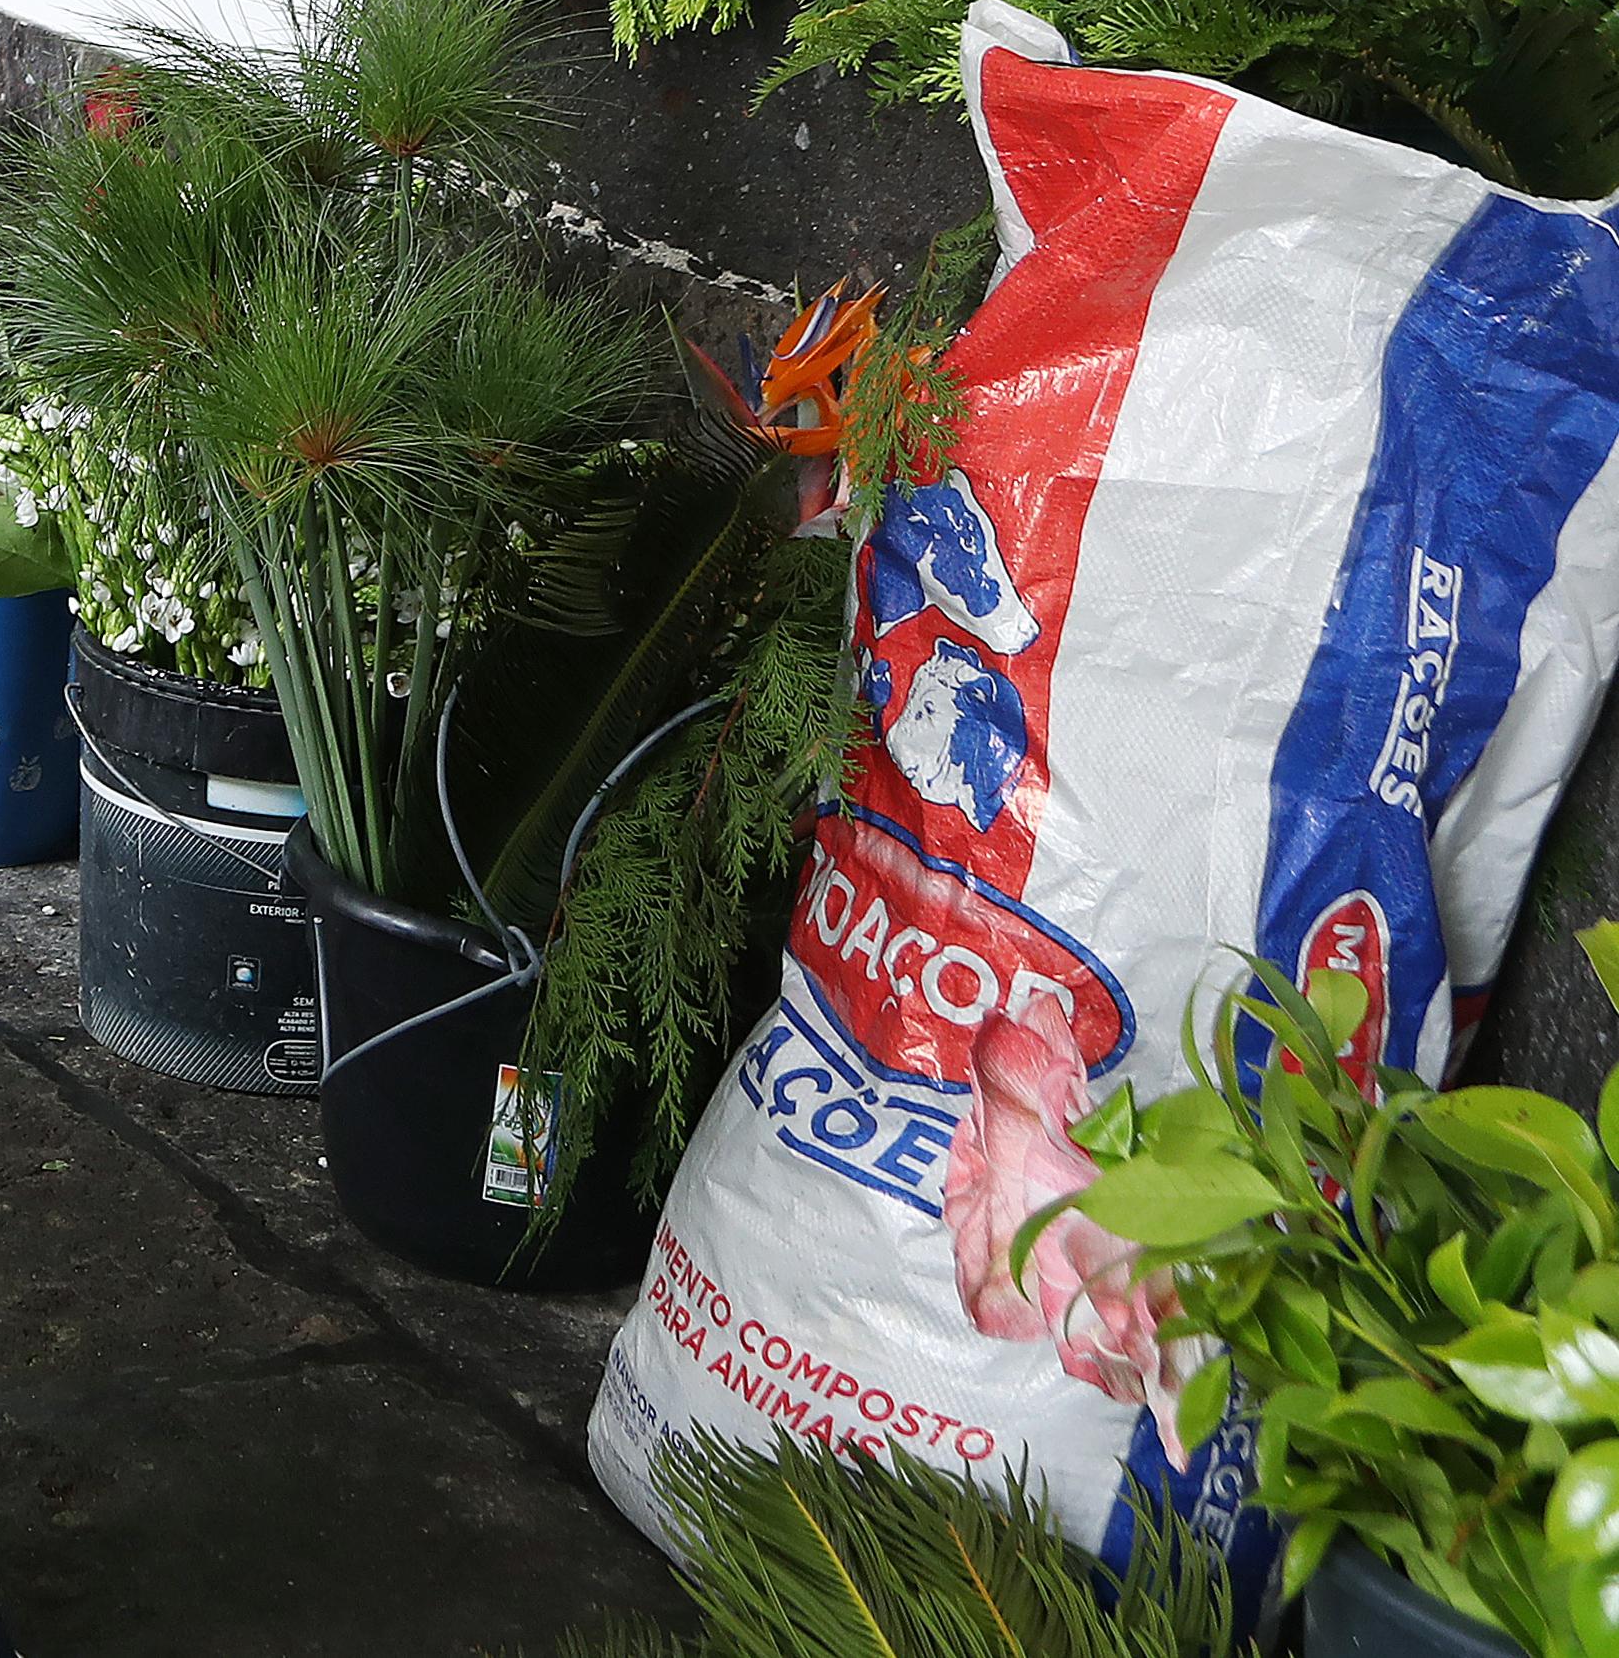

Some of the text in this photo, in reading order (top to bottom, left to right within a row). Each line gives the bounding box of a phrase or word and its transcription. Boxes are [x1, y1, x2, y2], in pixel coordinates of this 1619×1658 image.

[1380, 555, 1454, 819] RAÇÕES
[249, 903, 300, 918] EXTERIOR
[746, 1025, 955, 1192] AÇÕE
[647, 1273, 708, 1362] PARA
[739, 1319, 995, 1461] COMPOSTO
